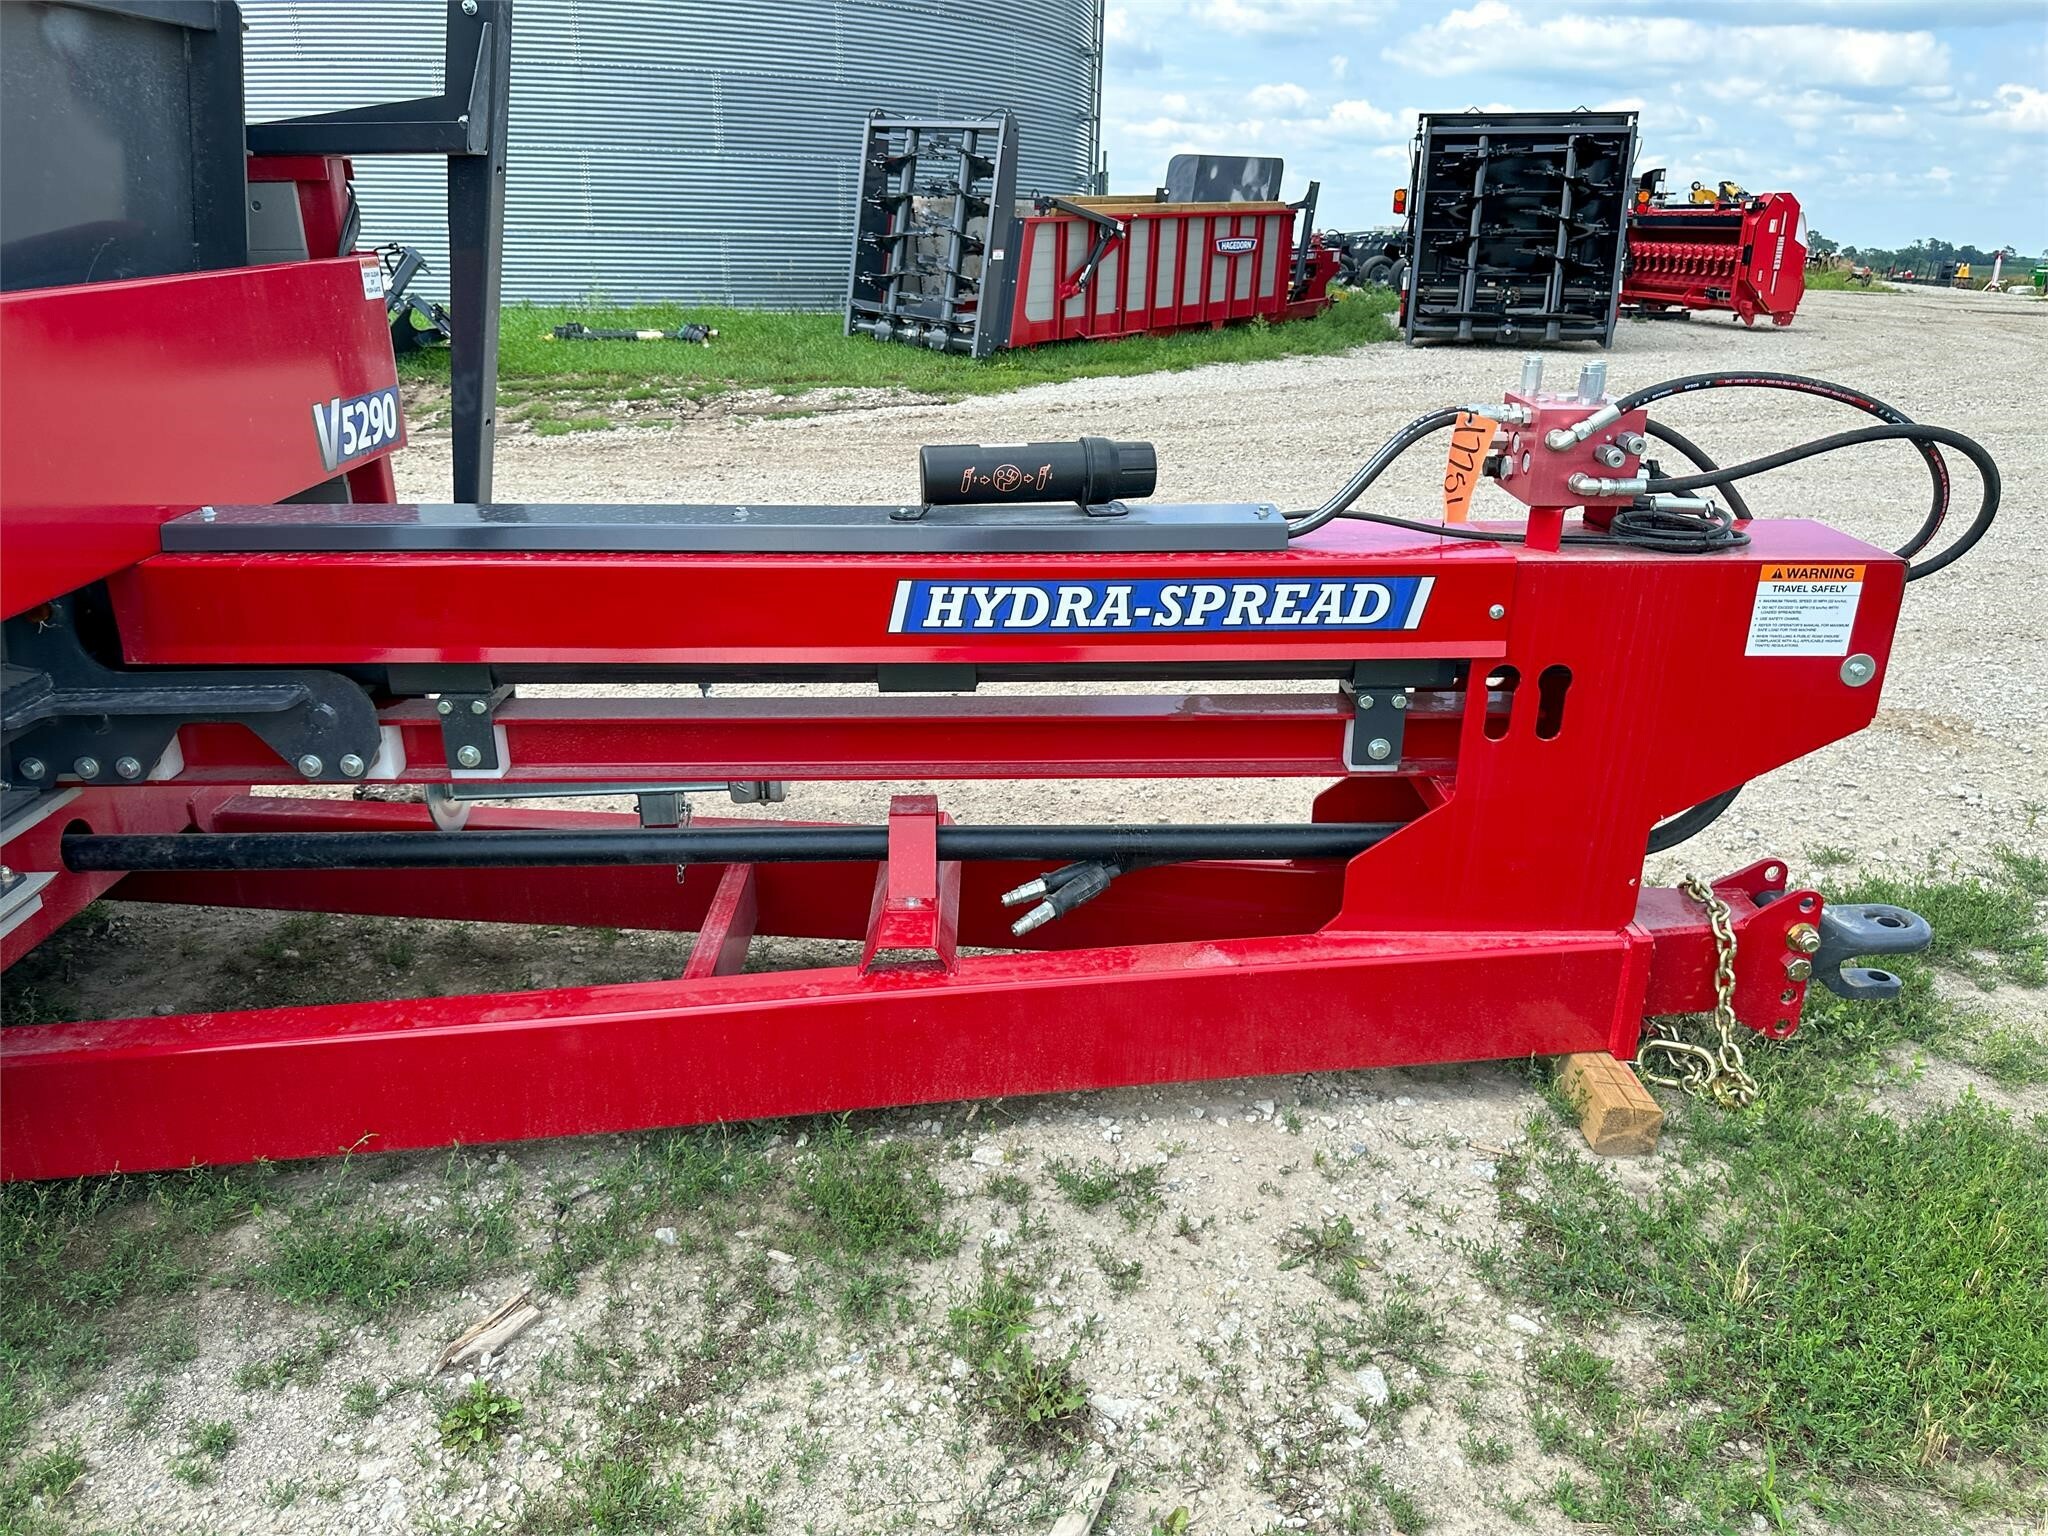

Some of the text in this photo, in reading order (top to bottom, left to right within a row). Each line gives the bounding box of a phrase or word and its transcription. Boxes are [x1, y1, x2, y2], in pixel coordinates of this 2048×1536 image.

[1220, 240, 1253, 250] HAGEDORN
[312, 391, 397, 473] V5290
[1444, 427, 1486, 505] 17751
[1786, 567, 1855, 580] WARNING
[1772, 584, 1848, 594] TRAVEL SAFELY
[921, 583, 1392, 628] HYDRA-SPREAD
